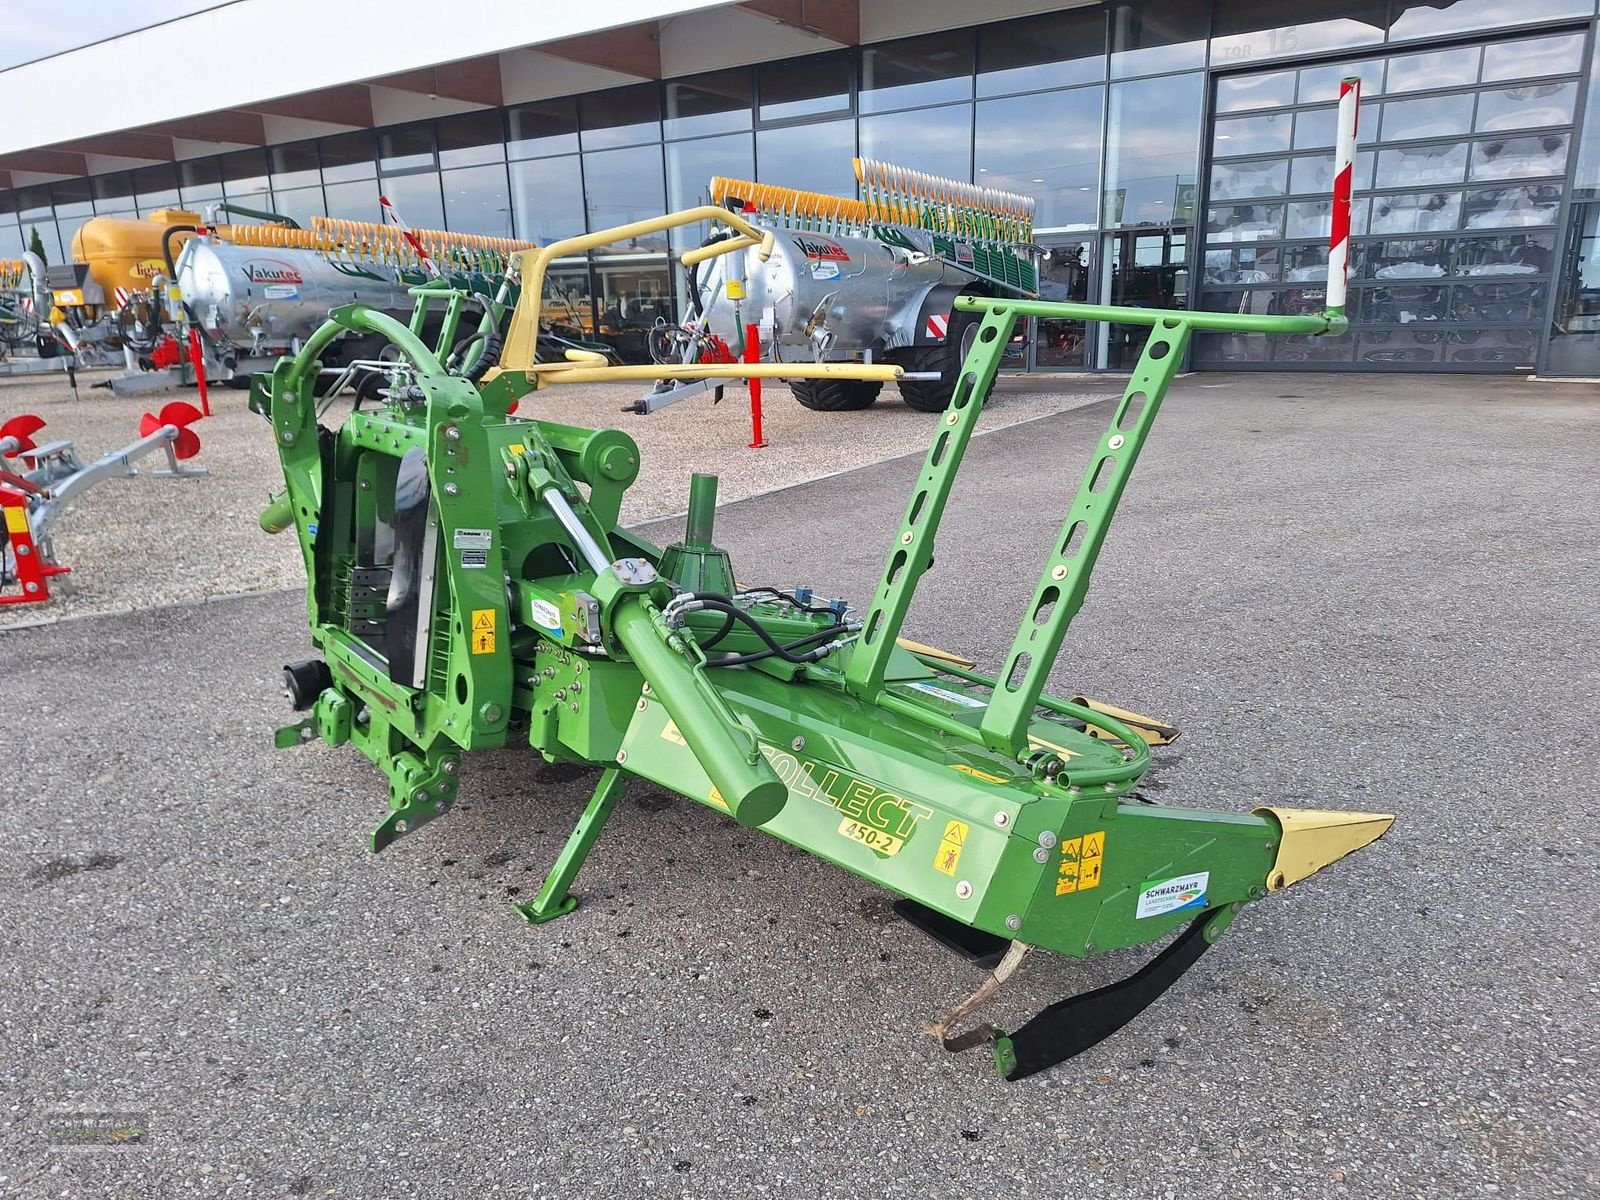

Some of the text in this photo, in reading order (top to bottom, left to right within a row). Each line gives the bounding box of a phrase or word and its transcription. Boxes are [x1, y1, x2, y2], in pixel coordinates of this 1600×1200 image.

[1223, 26, 1299, 58] TOR 16
[795, 237, 849, 258] Vakutec
[241, 264, 302, 282] Vakutec
[845, 822, 894, 852] 450-2
[1145, 881, 1199, 899] SCHWARZMAYR
